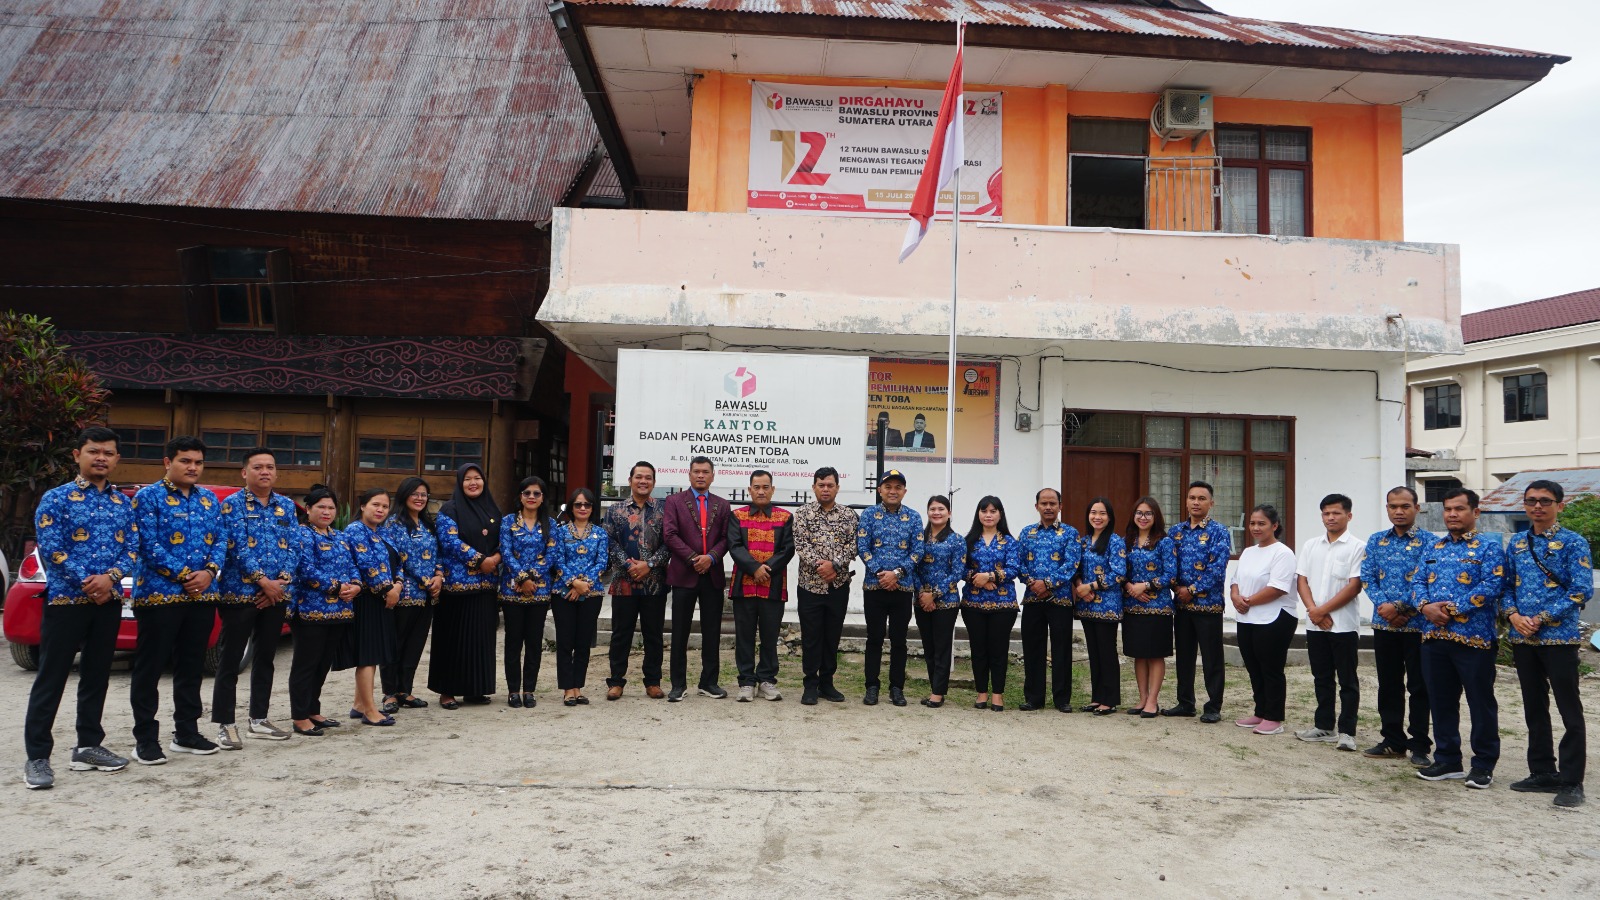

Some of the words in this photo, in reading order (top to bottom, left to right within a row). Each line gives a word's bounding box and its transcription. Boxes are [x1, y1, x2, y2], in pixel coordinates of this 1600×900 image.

[785, 97, 833, 107] BAWASLU
[839, 96, 924, 108] DIRGAHAYU
[839, 106, 889, 116] BAWASLU
[893, 109, 939, 118] PROVINS
[838, 116, 895, 125] SUMATERA
[898, 118, 933, 126] UTARA
[881, 147, 919, 155] BAWASLU
[839, 166, 869, 174] PEMILU
[890, 168, 923, 176] PEMILIH
[869, 371, 892, 381] TOR
[870, 383, 922, 393] PEMILIHAN
[925, 385, 948, 393] UMU
[885, 394, 911, 403] TOBA
[715, 399, 768, 410] BAWASLU
[704, 419, 777, 431] KANTOR
[639, 431, 678, 441] BADAN
[681, 432, 743, 443] PENGAWAS
[746, 434, 805, 445] PEMILIHAN
[808, 436, 842, 446] UMUM
[690, 444, 756, 456] KABUPATEN
[759, 447, 790, 457] TOBA
